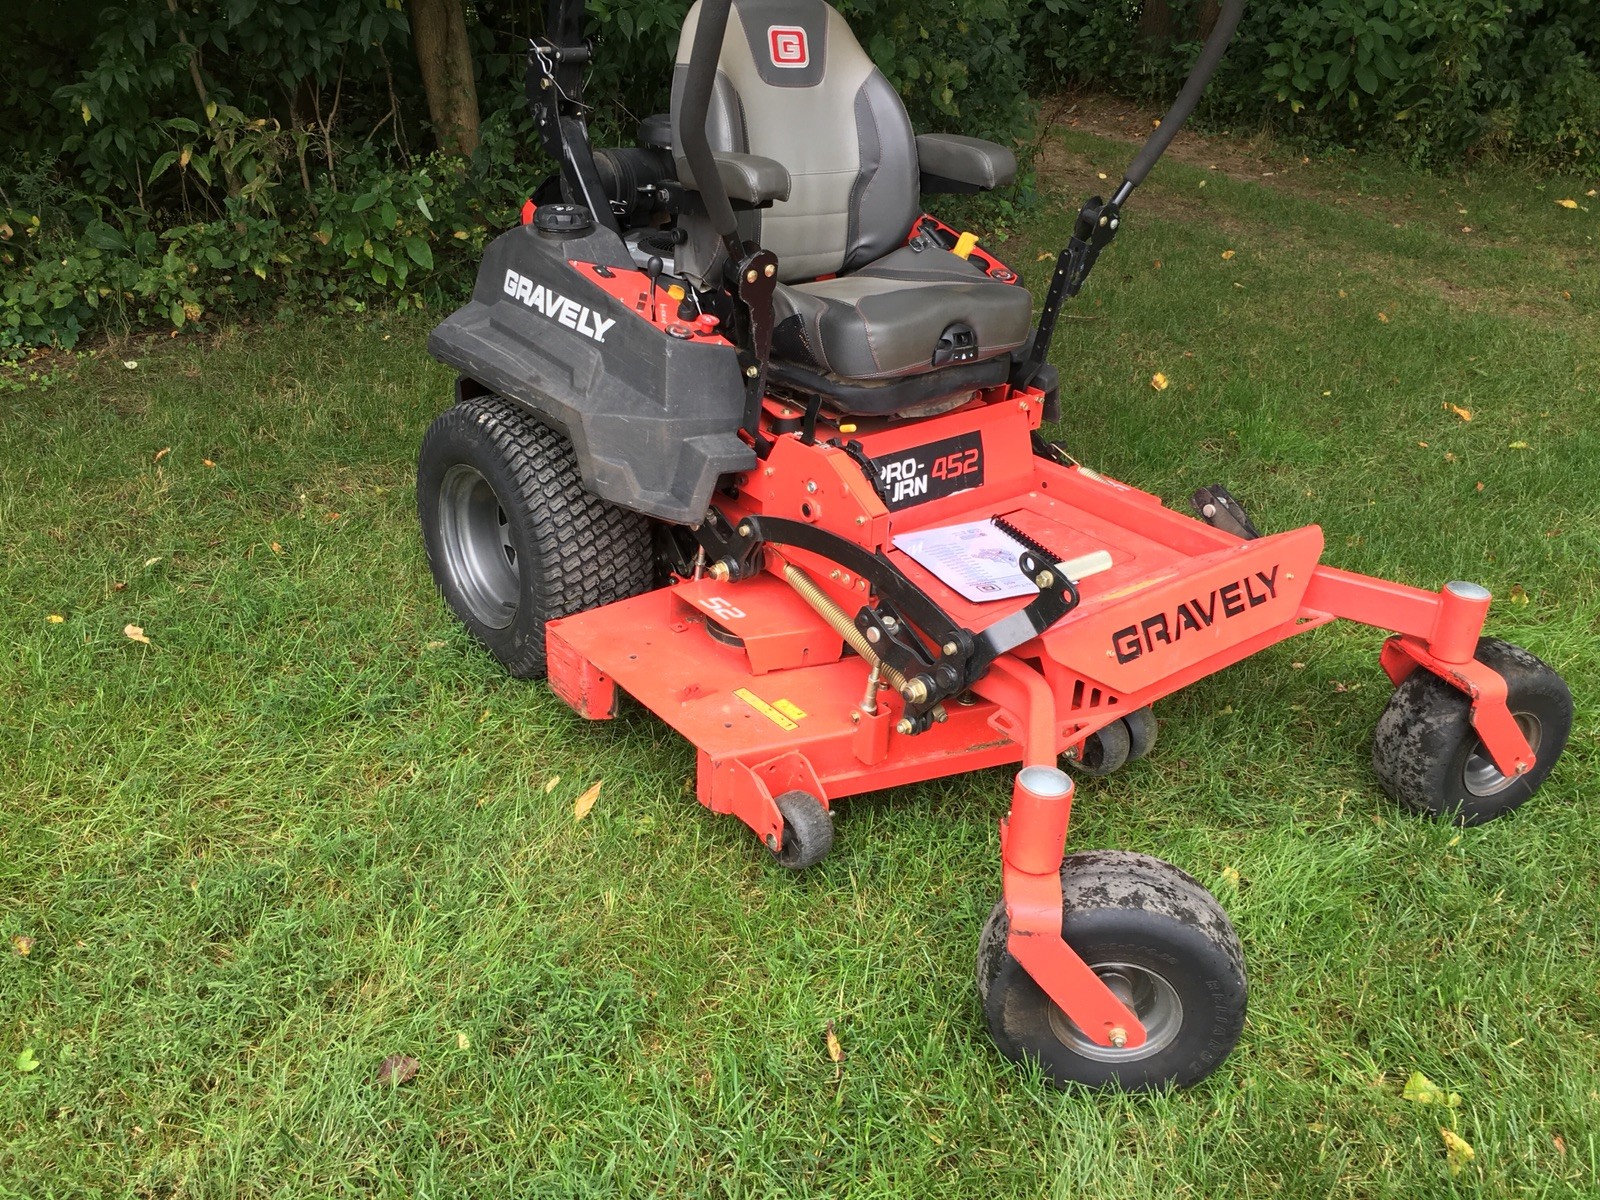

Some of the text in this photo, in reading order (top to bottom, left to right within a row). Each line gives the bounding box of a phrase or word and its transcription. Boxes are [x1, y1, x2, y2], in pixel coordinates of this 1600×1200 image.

[503, 268, 617, 342] GRAVELY
[931, 448, 979, 480] 452
[884, 474, 928, 502] RN
[698, 597, 746, 620] 52
[1111, 563, 1280, 665] GRAVELY
